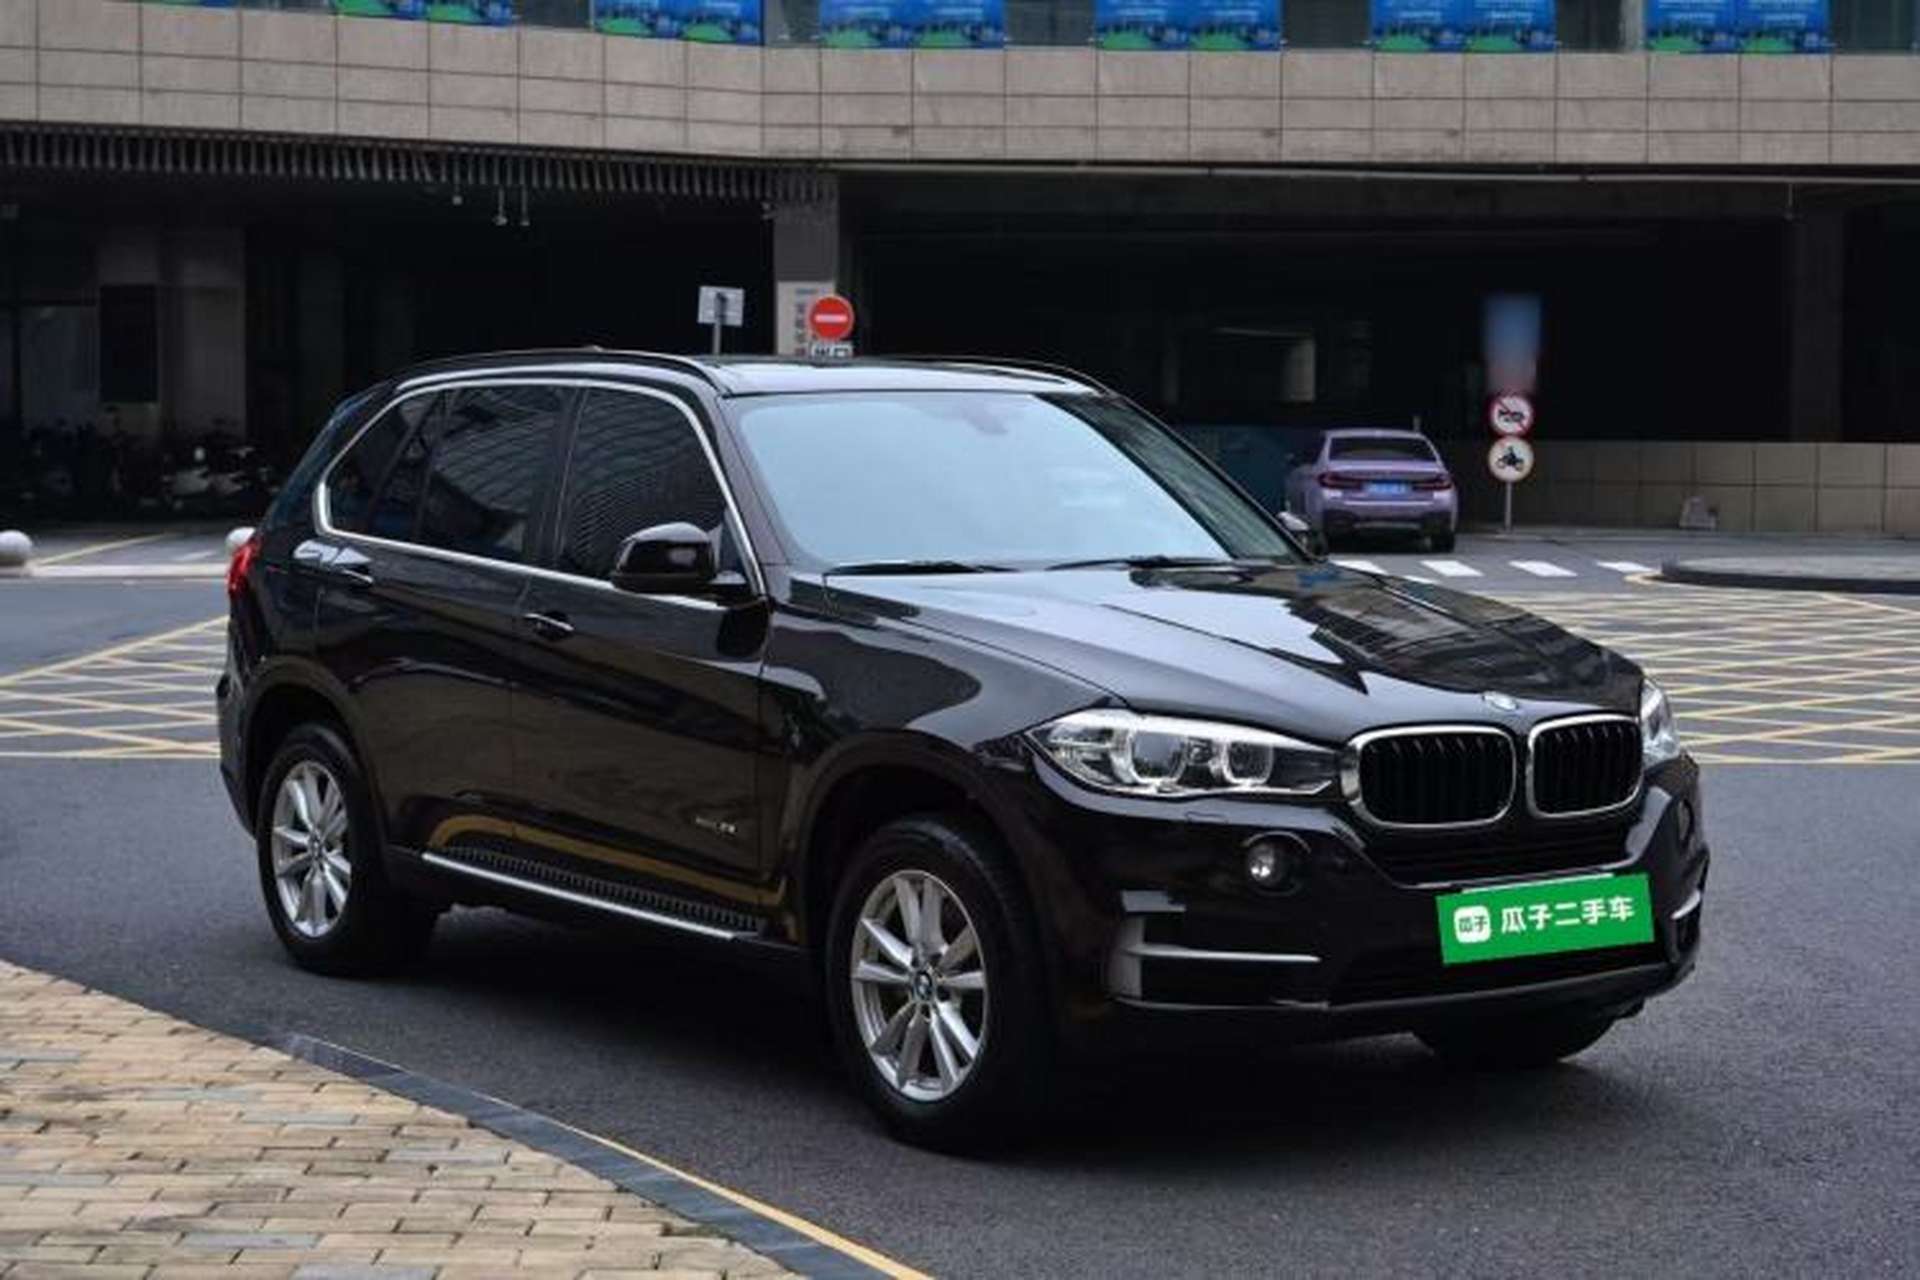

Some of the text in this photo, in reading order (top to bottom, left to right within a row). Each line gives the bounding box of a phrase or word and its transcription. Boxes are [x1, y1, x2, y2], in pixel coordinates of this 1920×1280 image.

[1501, 896, 1636, 934] 瓜子二手车
